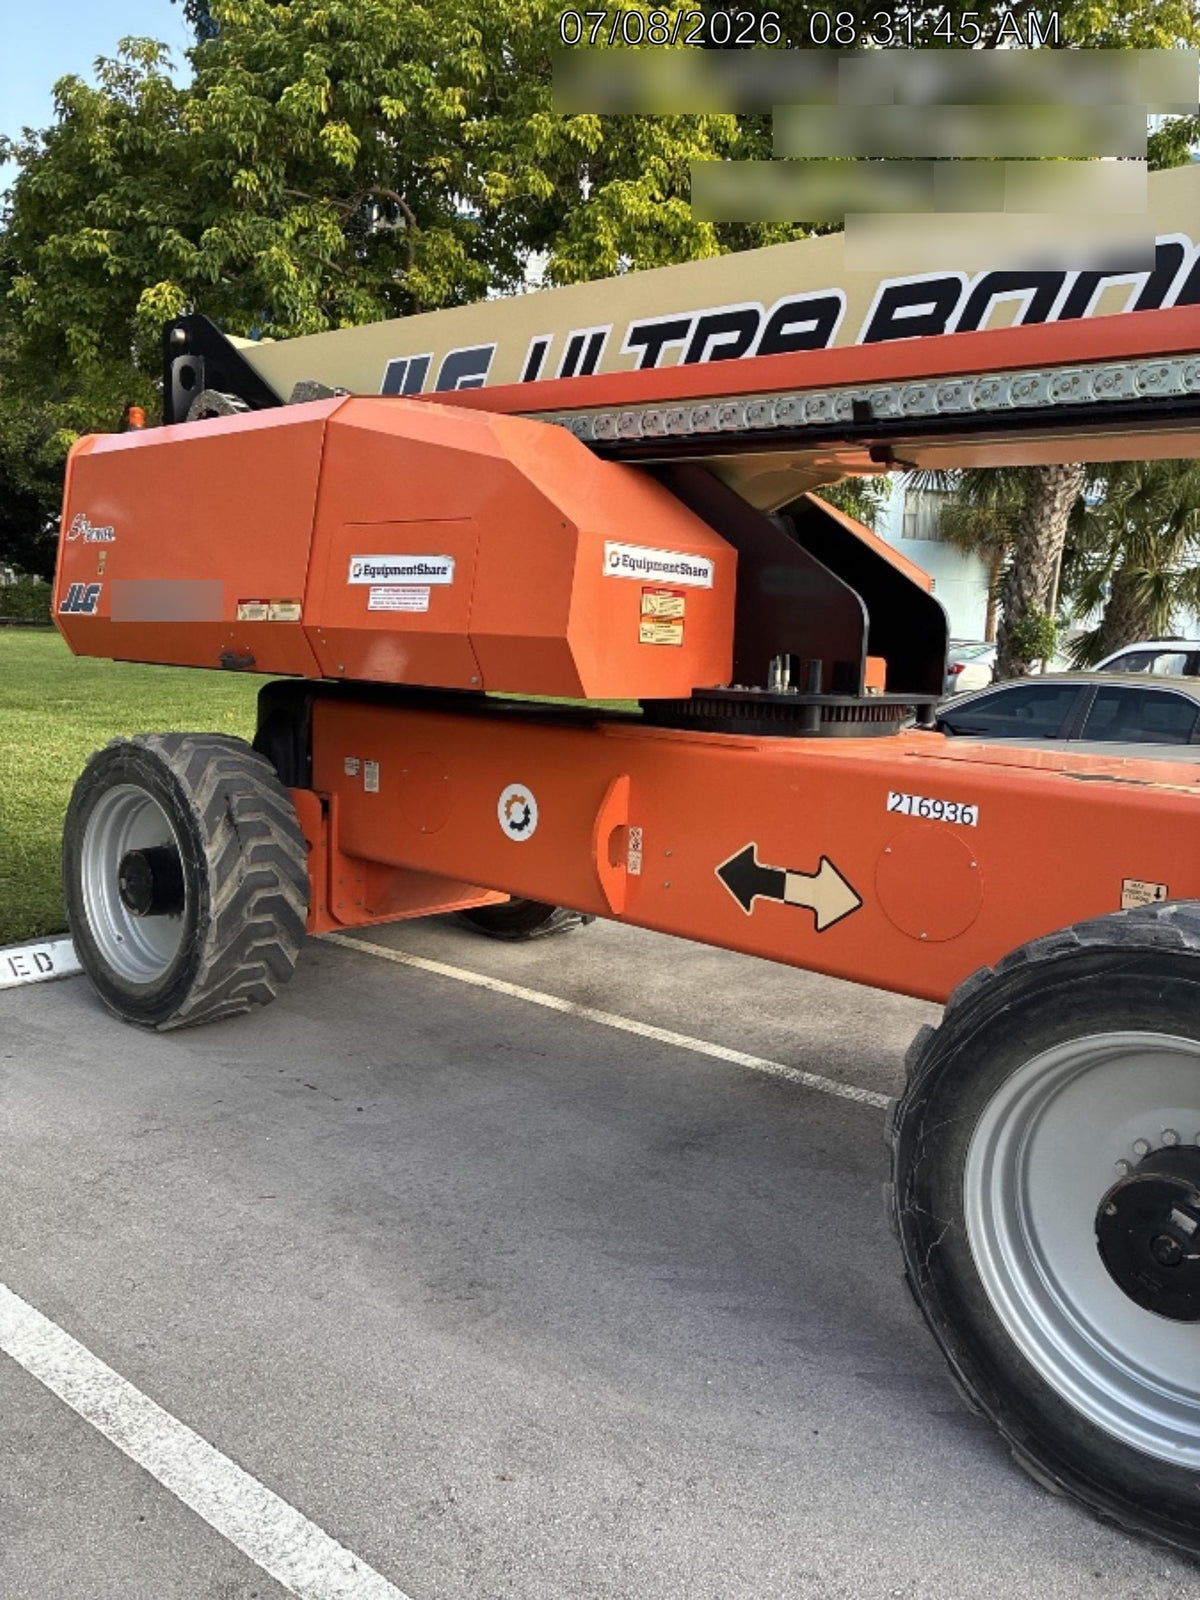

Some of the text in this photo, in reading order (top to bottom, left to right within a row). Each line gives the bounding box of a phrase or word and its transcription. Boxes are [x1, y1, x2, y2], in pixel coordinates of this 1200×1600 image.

[362, 563, 448, 578] EquipmentShare
[621, 553, 709, 579] EquipmentShare
[58, 582, 103, 615] JLG
[890, 792, 974, 826] 216936
